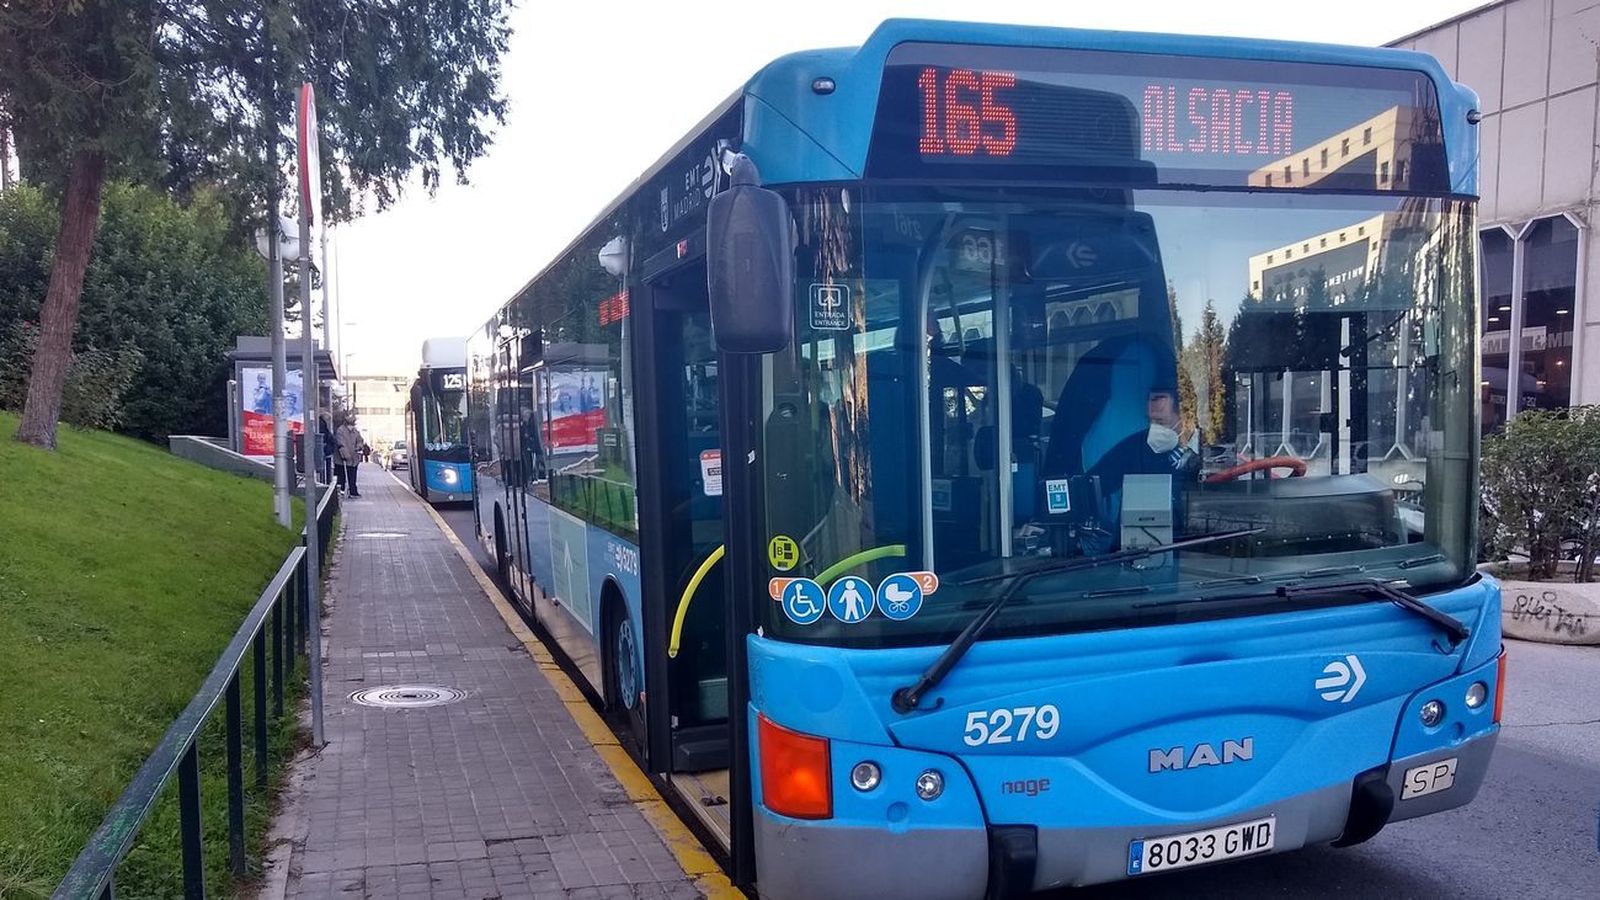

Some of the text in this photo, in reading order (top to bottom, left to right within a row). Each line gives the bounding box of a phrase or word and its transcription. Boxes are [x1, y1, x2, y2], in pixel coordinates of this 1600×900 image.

[918, 67, 1293, 155] 165 ALSACIA
[685, 164, 700, 191] EMT
[814, 311, 845, 319] ENTRADA
[814, 319, 846, 327] ENTRANCE
[443, 373, 462, 389] 125
[1048, 483, 1066, 492] EMT
[771, 581, 780, 595] 1
[922, 575, 933, 590] 2
[963, 704, 1060, 747] 5279
[1148, 737, 1254, 773] MAN
[1001, 778, 1051, 797] noge
[1132, 822, 1271, 869] E 8033 GWD
